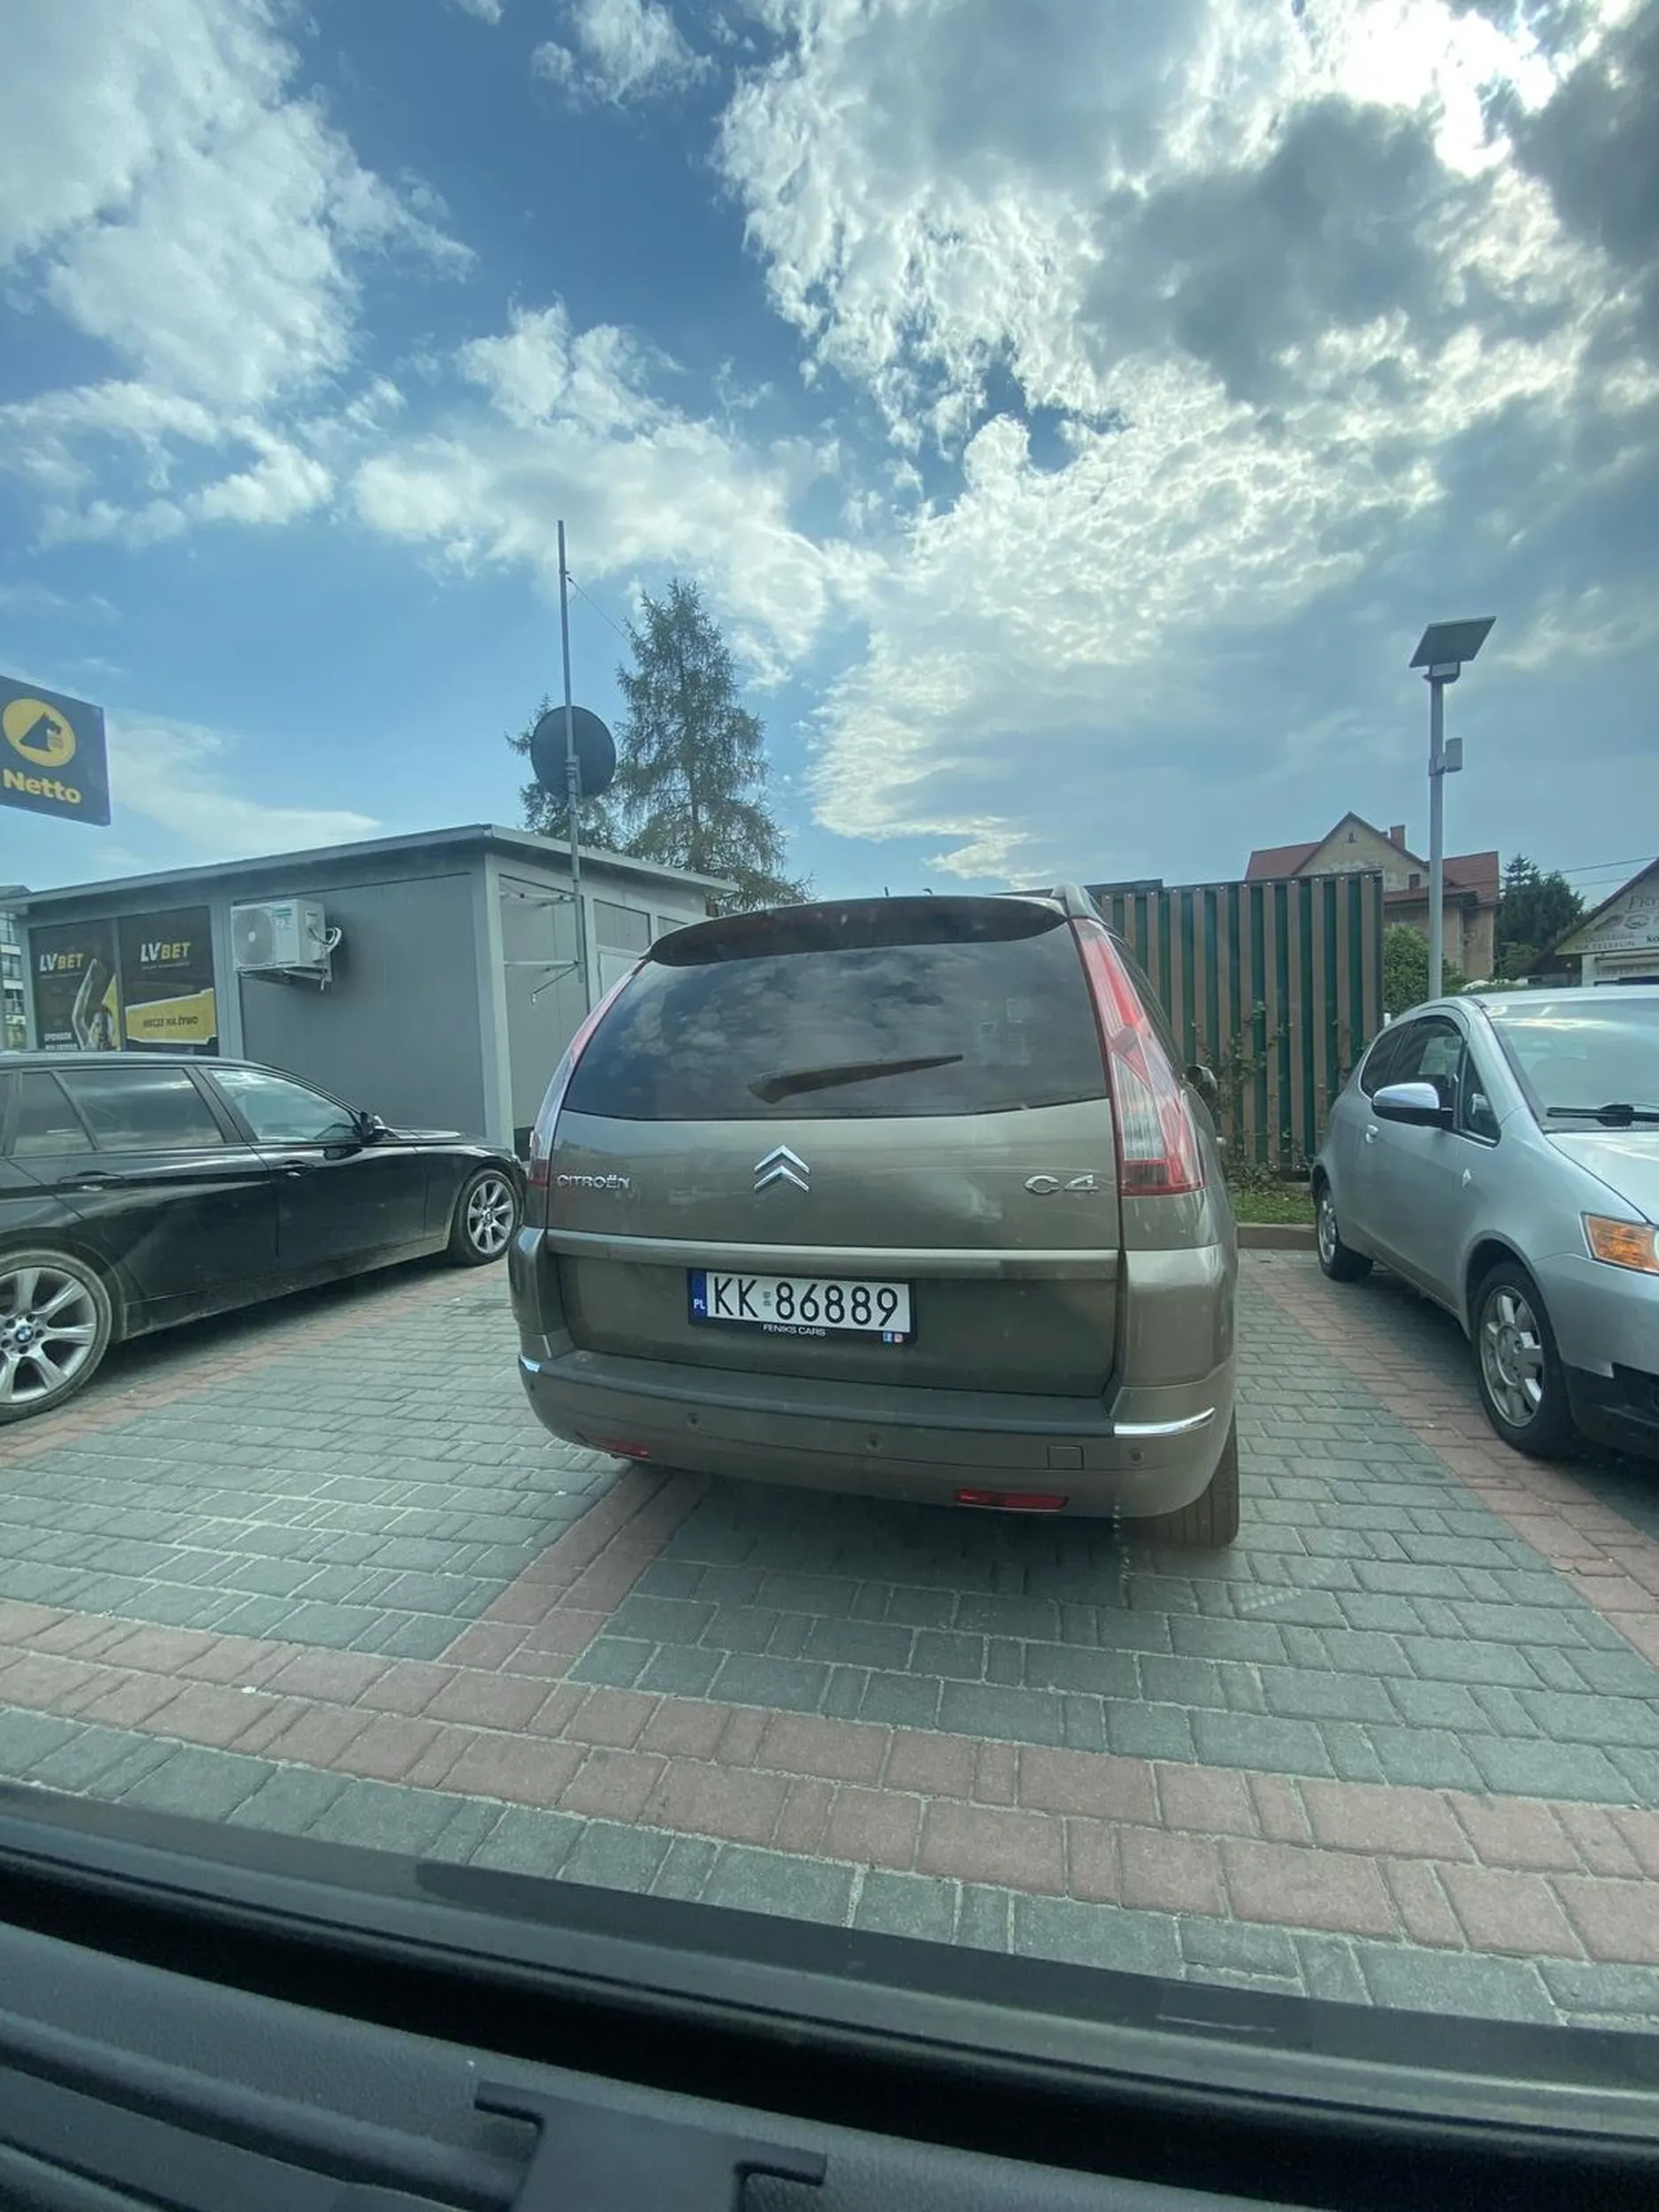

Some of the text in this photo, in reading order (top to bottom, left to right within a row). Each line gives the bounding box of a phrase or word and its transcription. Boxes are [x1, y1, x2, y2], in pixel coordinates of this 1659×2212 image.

[3, 769, 81, 804] Netto
[557, 1174, 630, 1188] CITROËN
[694, 1299, 705, 1310] PL
[714, 1277, 899, 1327] KK 86889
[763, 1324, 826, 1337] FENIKS CARS
